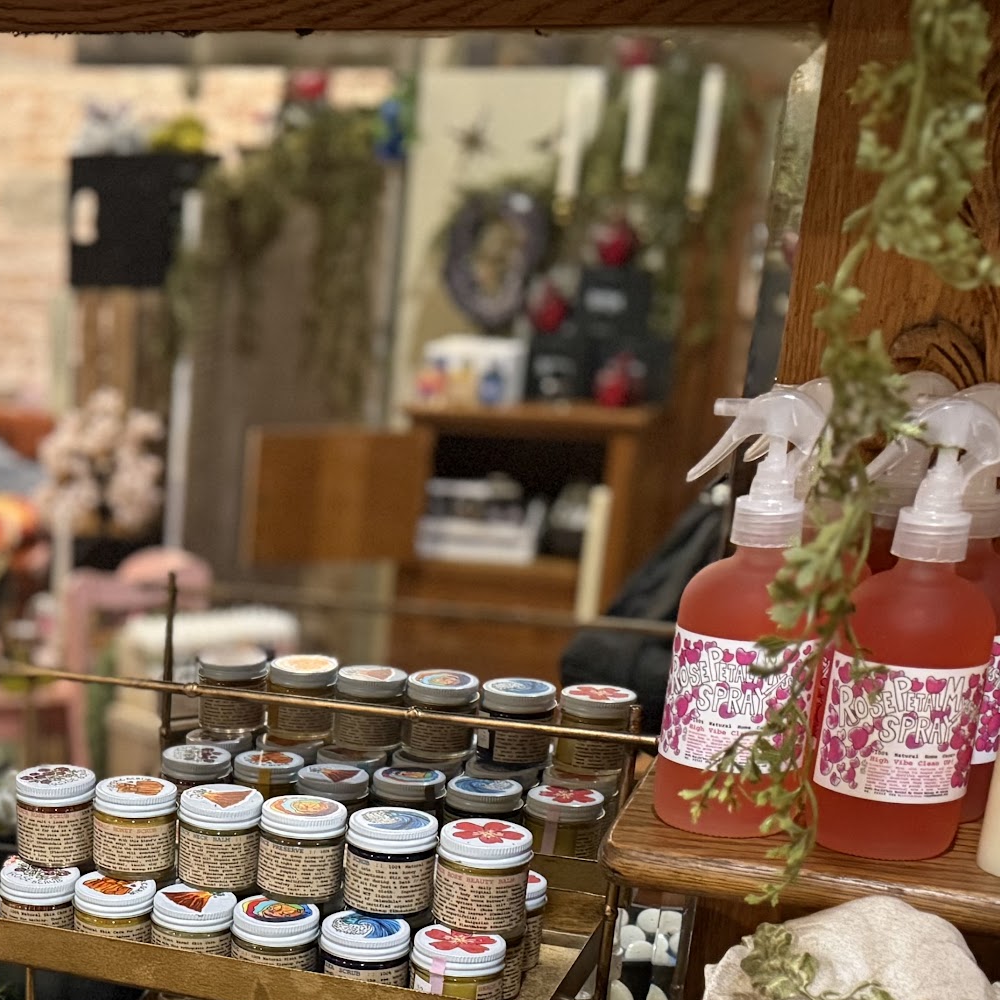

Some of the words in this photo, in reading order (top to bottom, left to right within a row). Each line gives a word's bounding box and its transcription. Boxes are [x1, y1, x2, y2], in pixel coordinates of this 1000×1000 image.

[696, 682, 766, 715] SPRAY
[839, 685, 896, 728] ROSE
[893, 675, 942, 712] PETAL
[689, 723, 704, 733] High
[709, 727, 727, 735] Vibe
[708, 721, 732, 729] Natural
[878, 715, 955, 744] SPRAY
[870, 756, 889, 764] High
[193, 832, 208, 841] NECK
[272, 843, 305, 854] PRESERVE
[466, 877, 494, 885] BEAUTY
[339, 967, 361, 977] SCRUB
